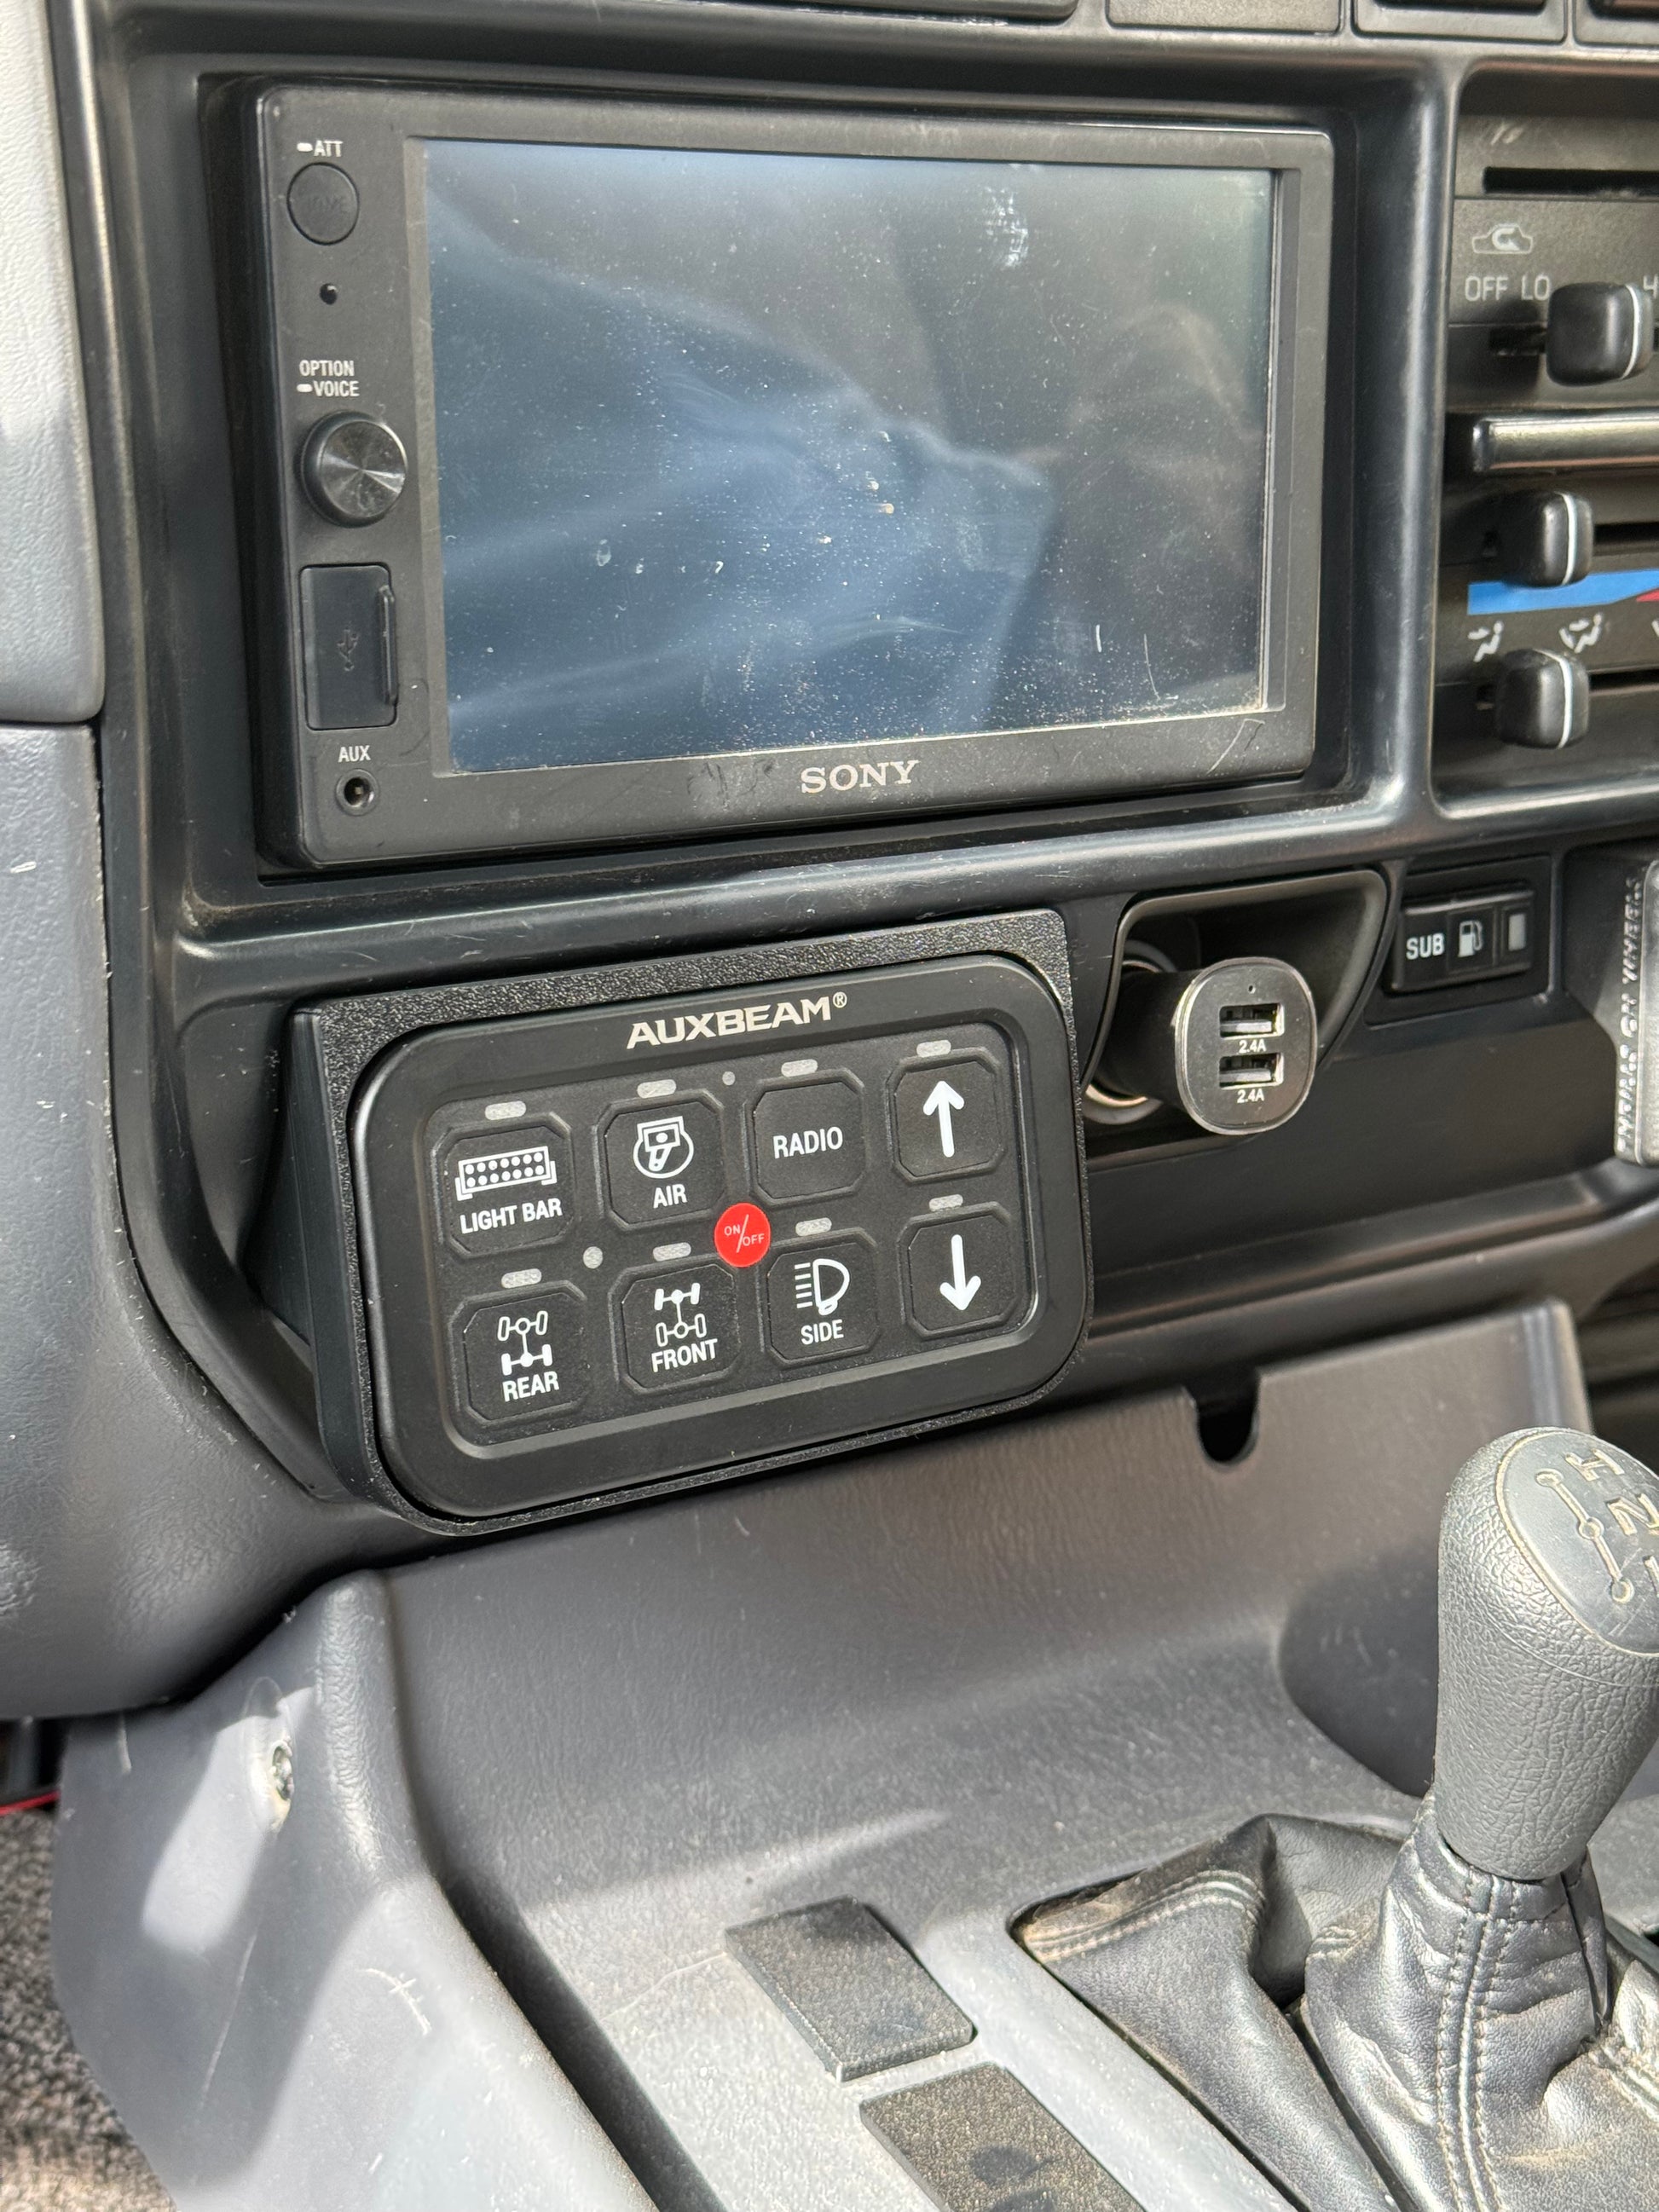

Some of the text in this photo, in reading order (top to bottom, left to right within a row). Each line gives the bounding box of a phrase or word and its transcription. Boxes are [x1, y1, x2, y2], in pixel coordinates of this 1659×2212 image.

[314, 141, 343, 157] ATT
[1465, 276, 1508, 300] OFF
[1522, 275, 1551, 300] LO
[299, 360, 355, 377] OPTION
[314, 381, 360, 396] VOICE
[338, 745, 371, 763] AUX
[801, 759, 919, 794] SONY
[1406, 933, 1445, 960] SUB
[1239, 1039, 1267, 1054] 2.4A
[1237, 1089, 1264, 1103] 2.4A
[773, 1126, 843, 1159] RADIO
[653, 1183, 687, 1209] AIR
[460, 1198, 563, 1234] LIGHT BAR
[801, 1319, 844, 1345] SIDE
[651, 1338, 719, 1372] FRONT
[502, 1371, 559, 1402] REAR
